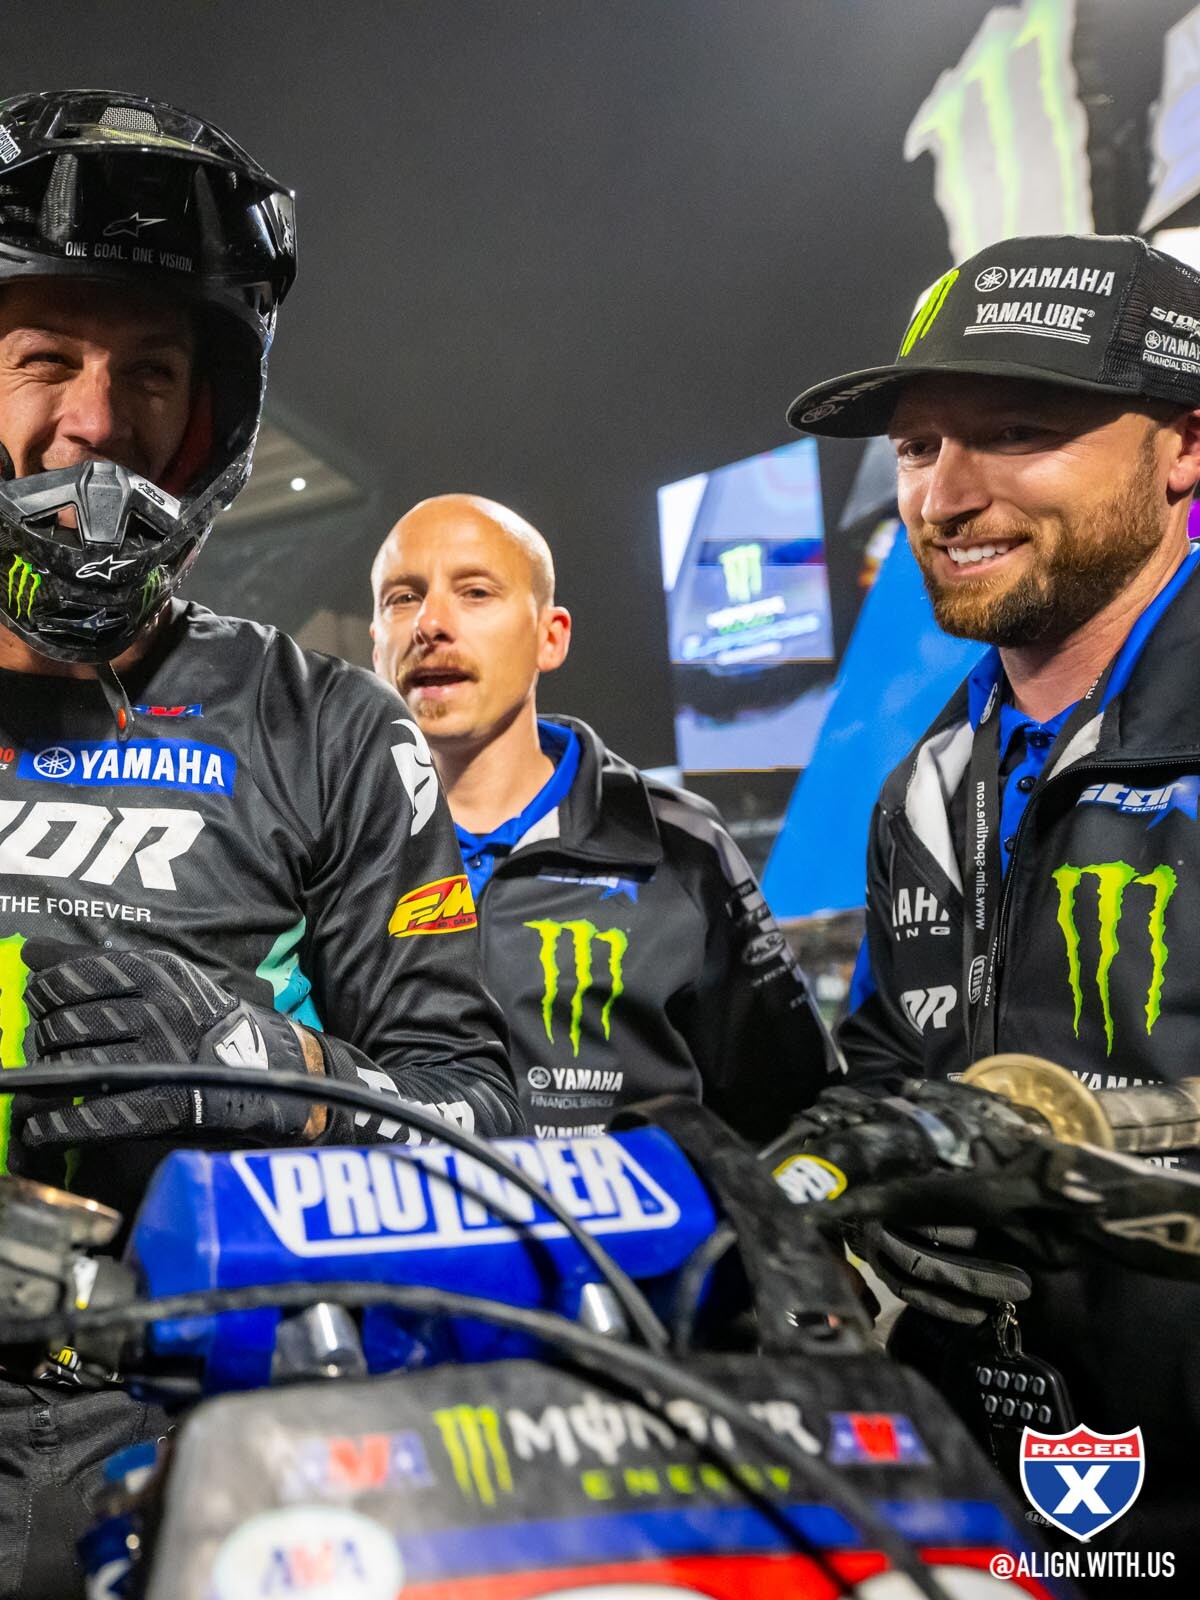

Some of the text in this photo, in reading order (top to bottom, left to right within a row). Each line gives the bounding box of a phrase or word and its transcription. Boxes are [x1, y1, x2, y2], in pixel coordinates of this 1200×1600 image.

[65, 241, 87, 257] ONE
[94, 243, 128, 260] GOAL.
[132, 247, 153, 263] ONE
[1008, 266, 1115, 296] YAMAHA
[1142, 353, 1181, 371] FINANCIAL
[81, 747, 224, 787] YAMAHA
[46, 898, 151, 922] FOREVER
[552, 1068, 623, 1091] YAMAHA
